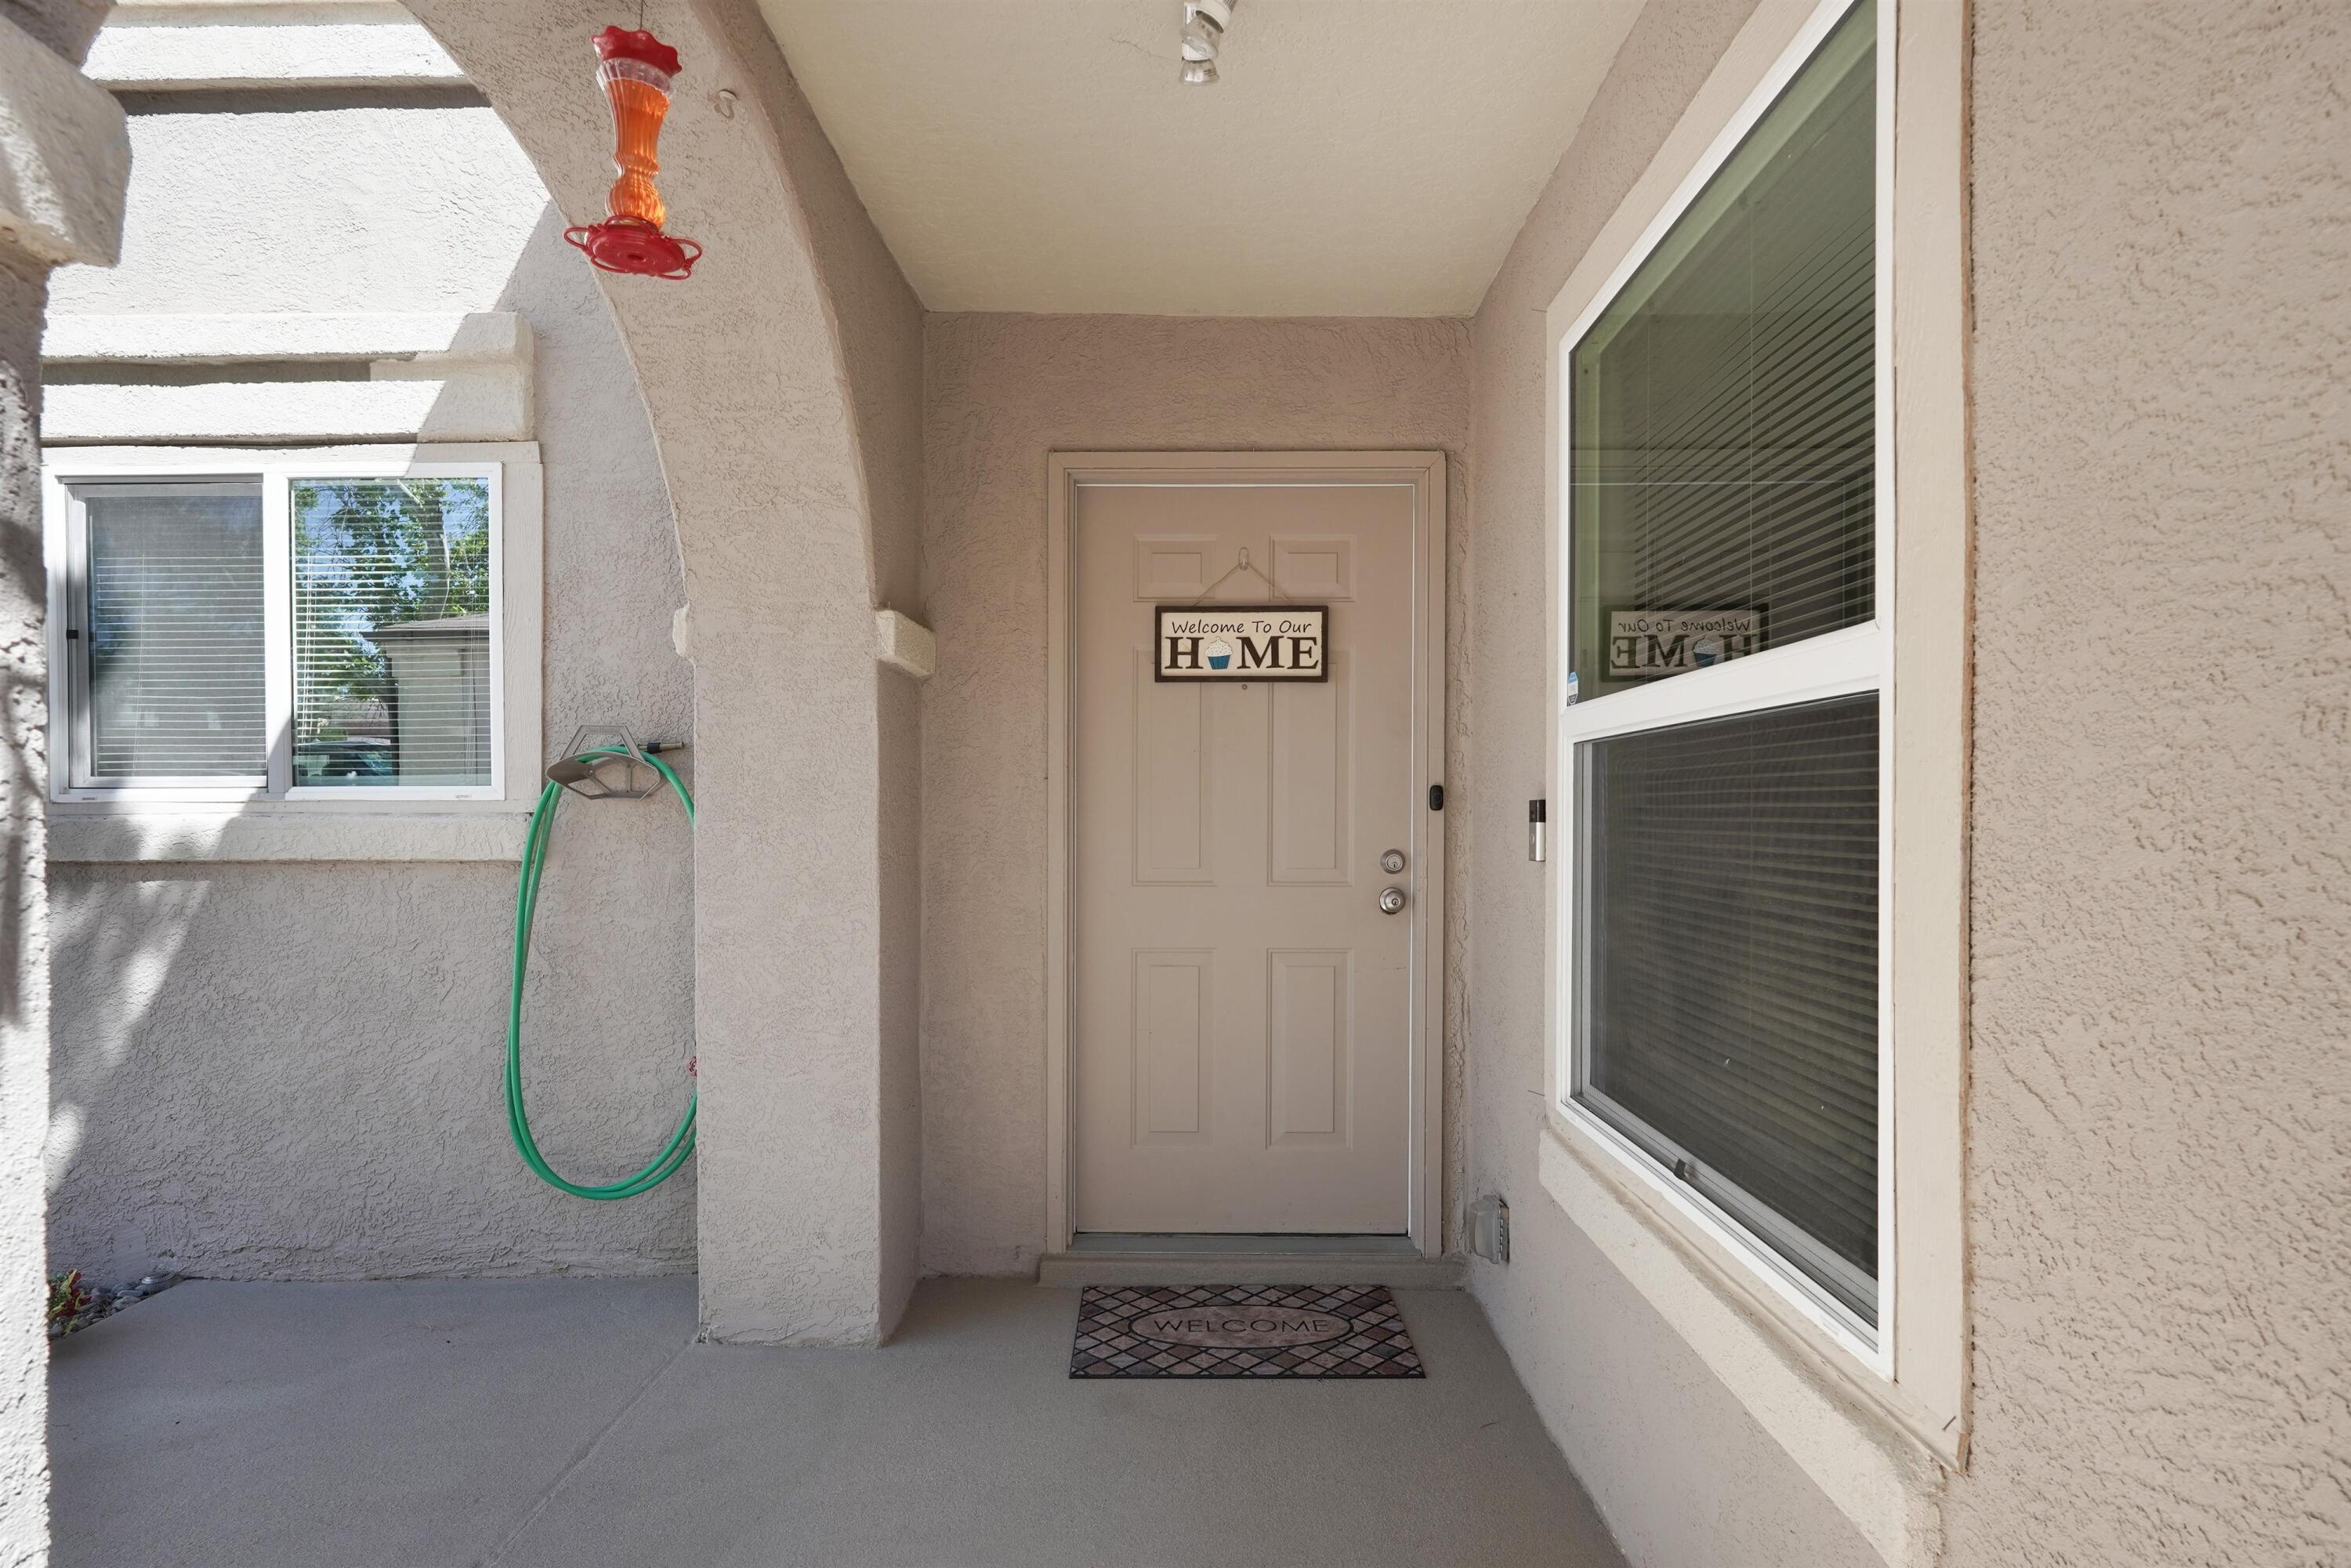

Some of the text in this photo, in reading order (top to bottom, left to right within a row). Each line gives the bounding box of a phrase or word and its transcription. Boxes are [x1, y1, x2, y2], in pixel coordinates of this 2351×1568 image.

[1172, 619, 1312, 634] Welcome To Our
[1165, 636, 1319, 669] HME
[1154, 1319, 1330, 1333] WELCOME
